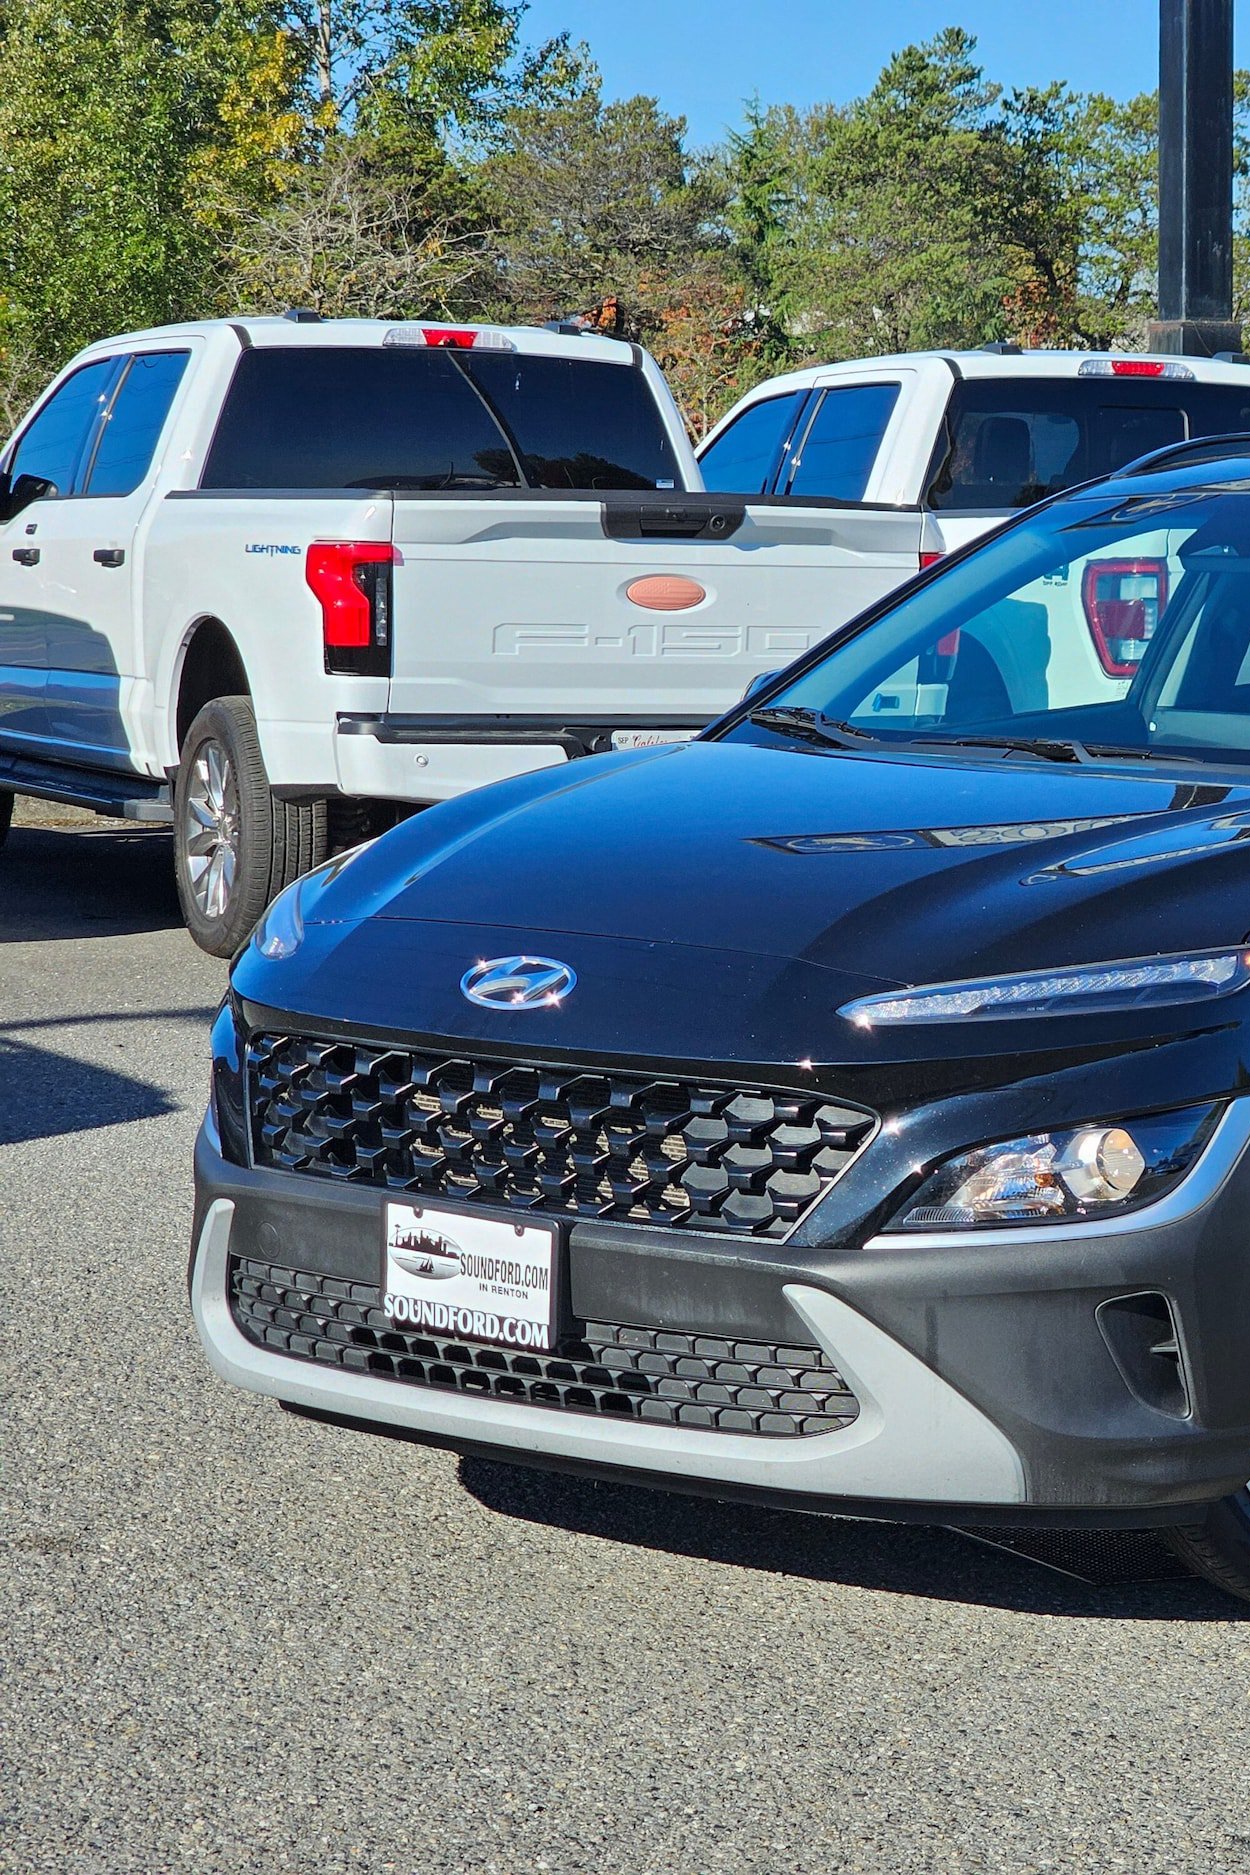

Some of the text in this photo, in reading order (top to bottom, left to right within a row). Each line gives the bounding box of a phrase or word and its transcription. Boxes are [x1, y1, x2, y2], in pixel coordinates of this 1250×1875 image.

[245, 544, 301, 557] LIGHTNING
[492, 623, 821, 657] F-150
[460, 1252, 549, 1291] SOUNDFORD.COM
[479, 1283, 529, 1300] IN RENTON
[383, 1292, 550, 1350] SOUNDFORD.COM
